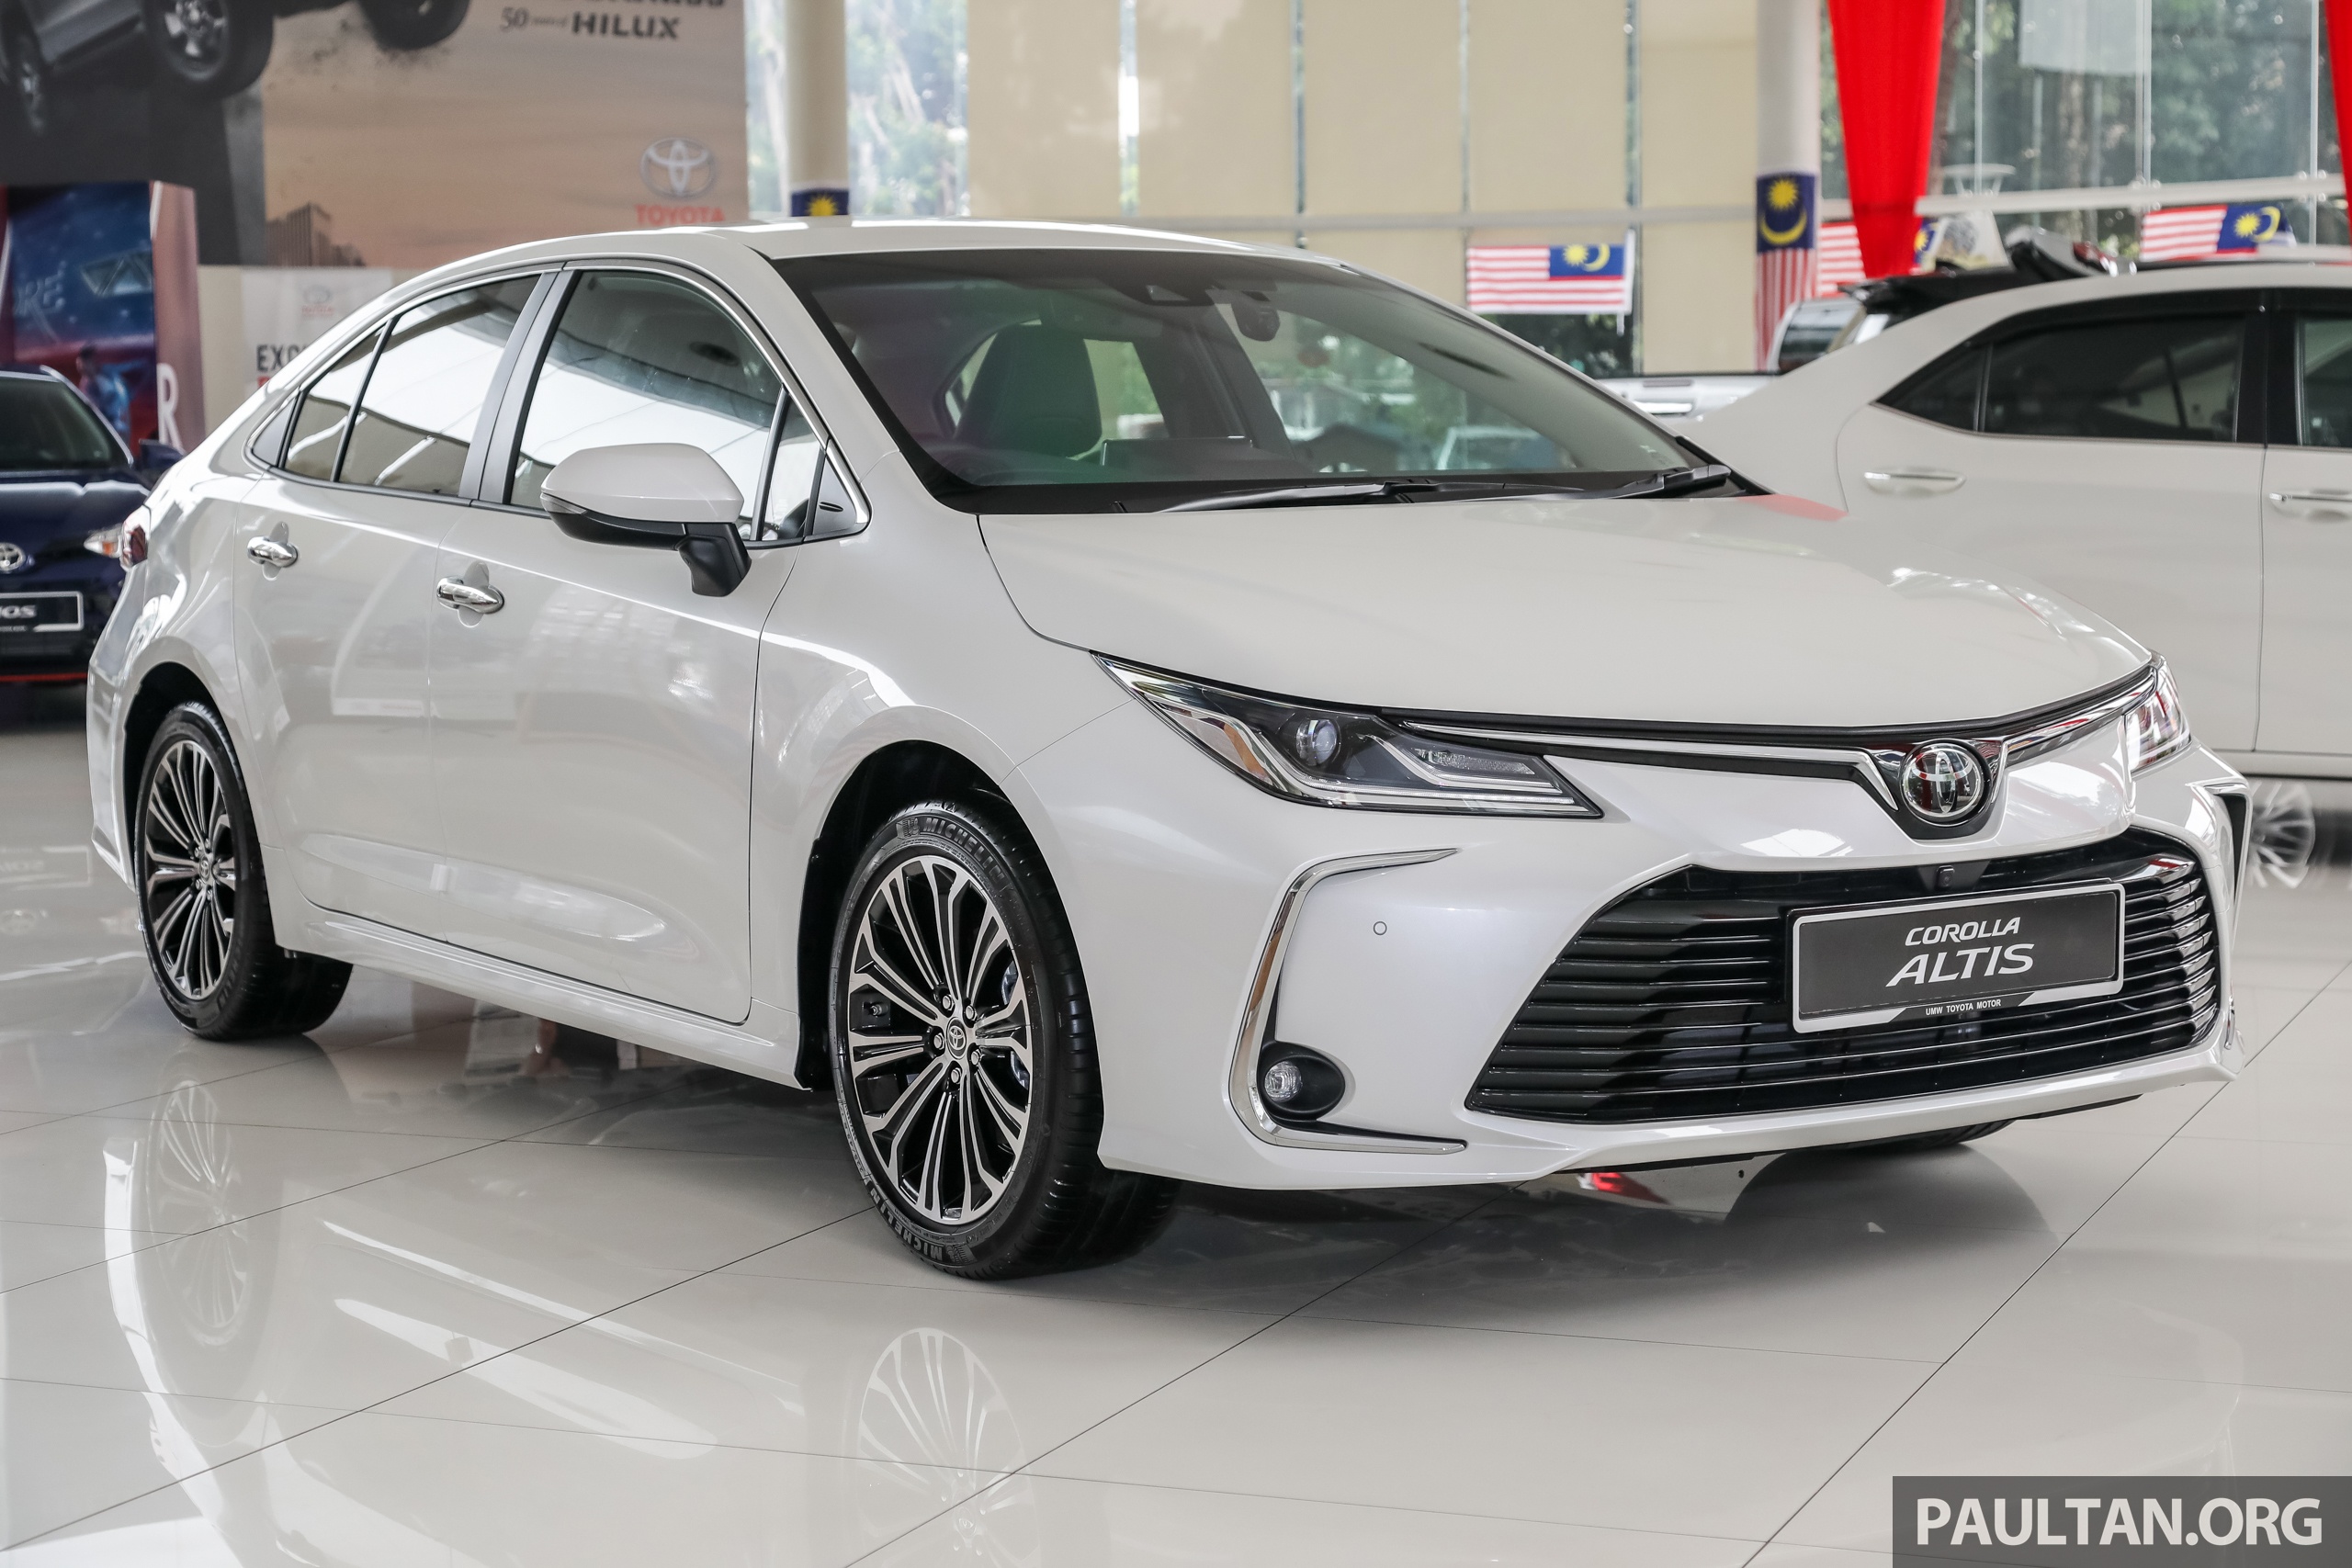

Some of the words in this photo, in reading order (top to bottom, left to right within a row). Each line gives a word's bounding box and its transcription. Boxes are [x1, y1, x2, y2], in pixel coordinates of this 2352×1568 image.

[500, 7, 530, 32] 50
[571, 11, 680, 39] HILUX
[634, 204, 726, 226] TOYOTA
[922, 817, 1006, 883] MICHELIN
[1905, 917, 2020, 947] COROLLA
[1885, 943, 2035, 987] ALTIS
[1926, 1006, 1943, 1016] UMW
[1946, 1002, 1973, 1013] TOYOTA
[1976, 998, 2001, 1010] MOTOR
[869, 1187, 944, 1261] MICHELIN
